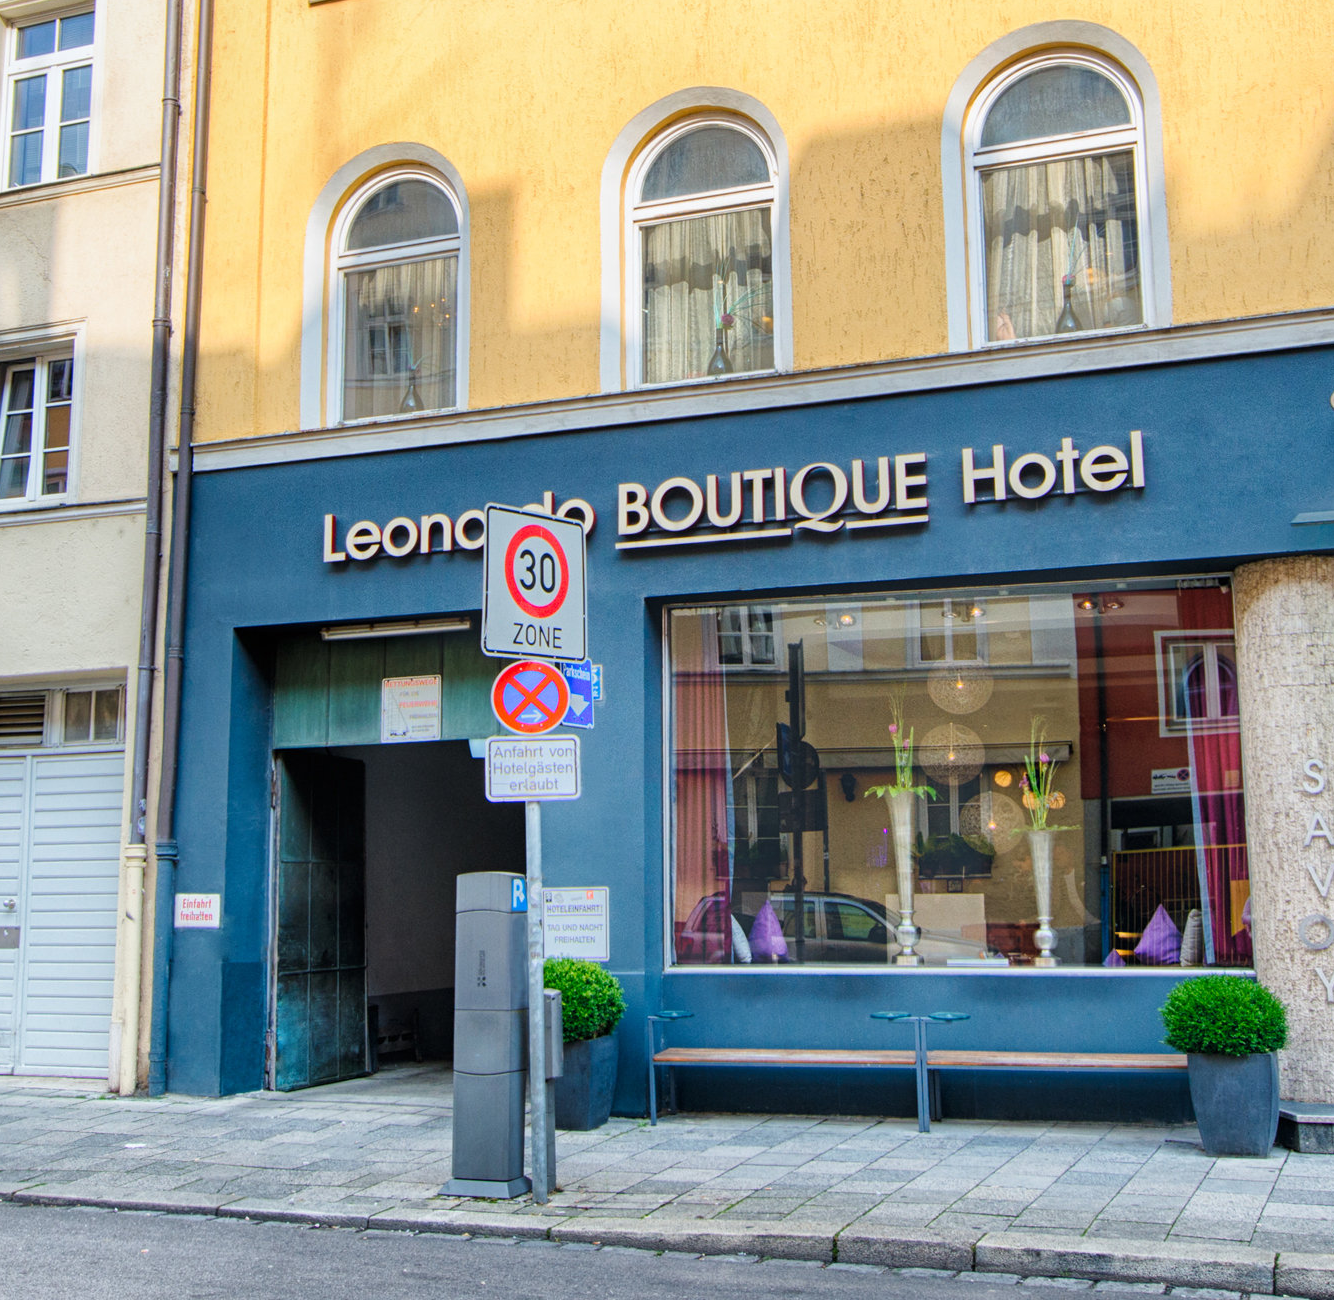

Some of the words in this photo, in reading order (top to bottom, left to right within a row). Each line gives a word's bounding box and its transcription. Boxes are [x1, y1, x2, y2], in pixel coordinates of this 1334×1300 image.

[617, 452, 929, 536] BOUTIQUE
[962, 430, 1146, 503] Hotel
[519, 549, 556, 594] 30
[513, 623, 563, 650] ZONE
[563, 663, 591, 681] Parkschein
[494, 745, 543, 759] Anfahrt
[549, 747, 573, 758] von
[493, 761, 573, 778] Hotelgästen
[509, 778, 559, 792] erlaubt
[182, 898, 212, 909] Einfahrt
